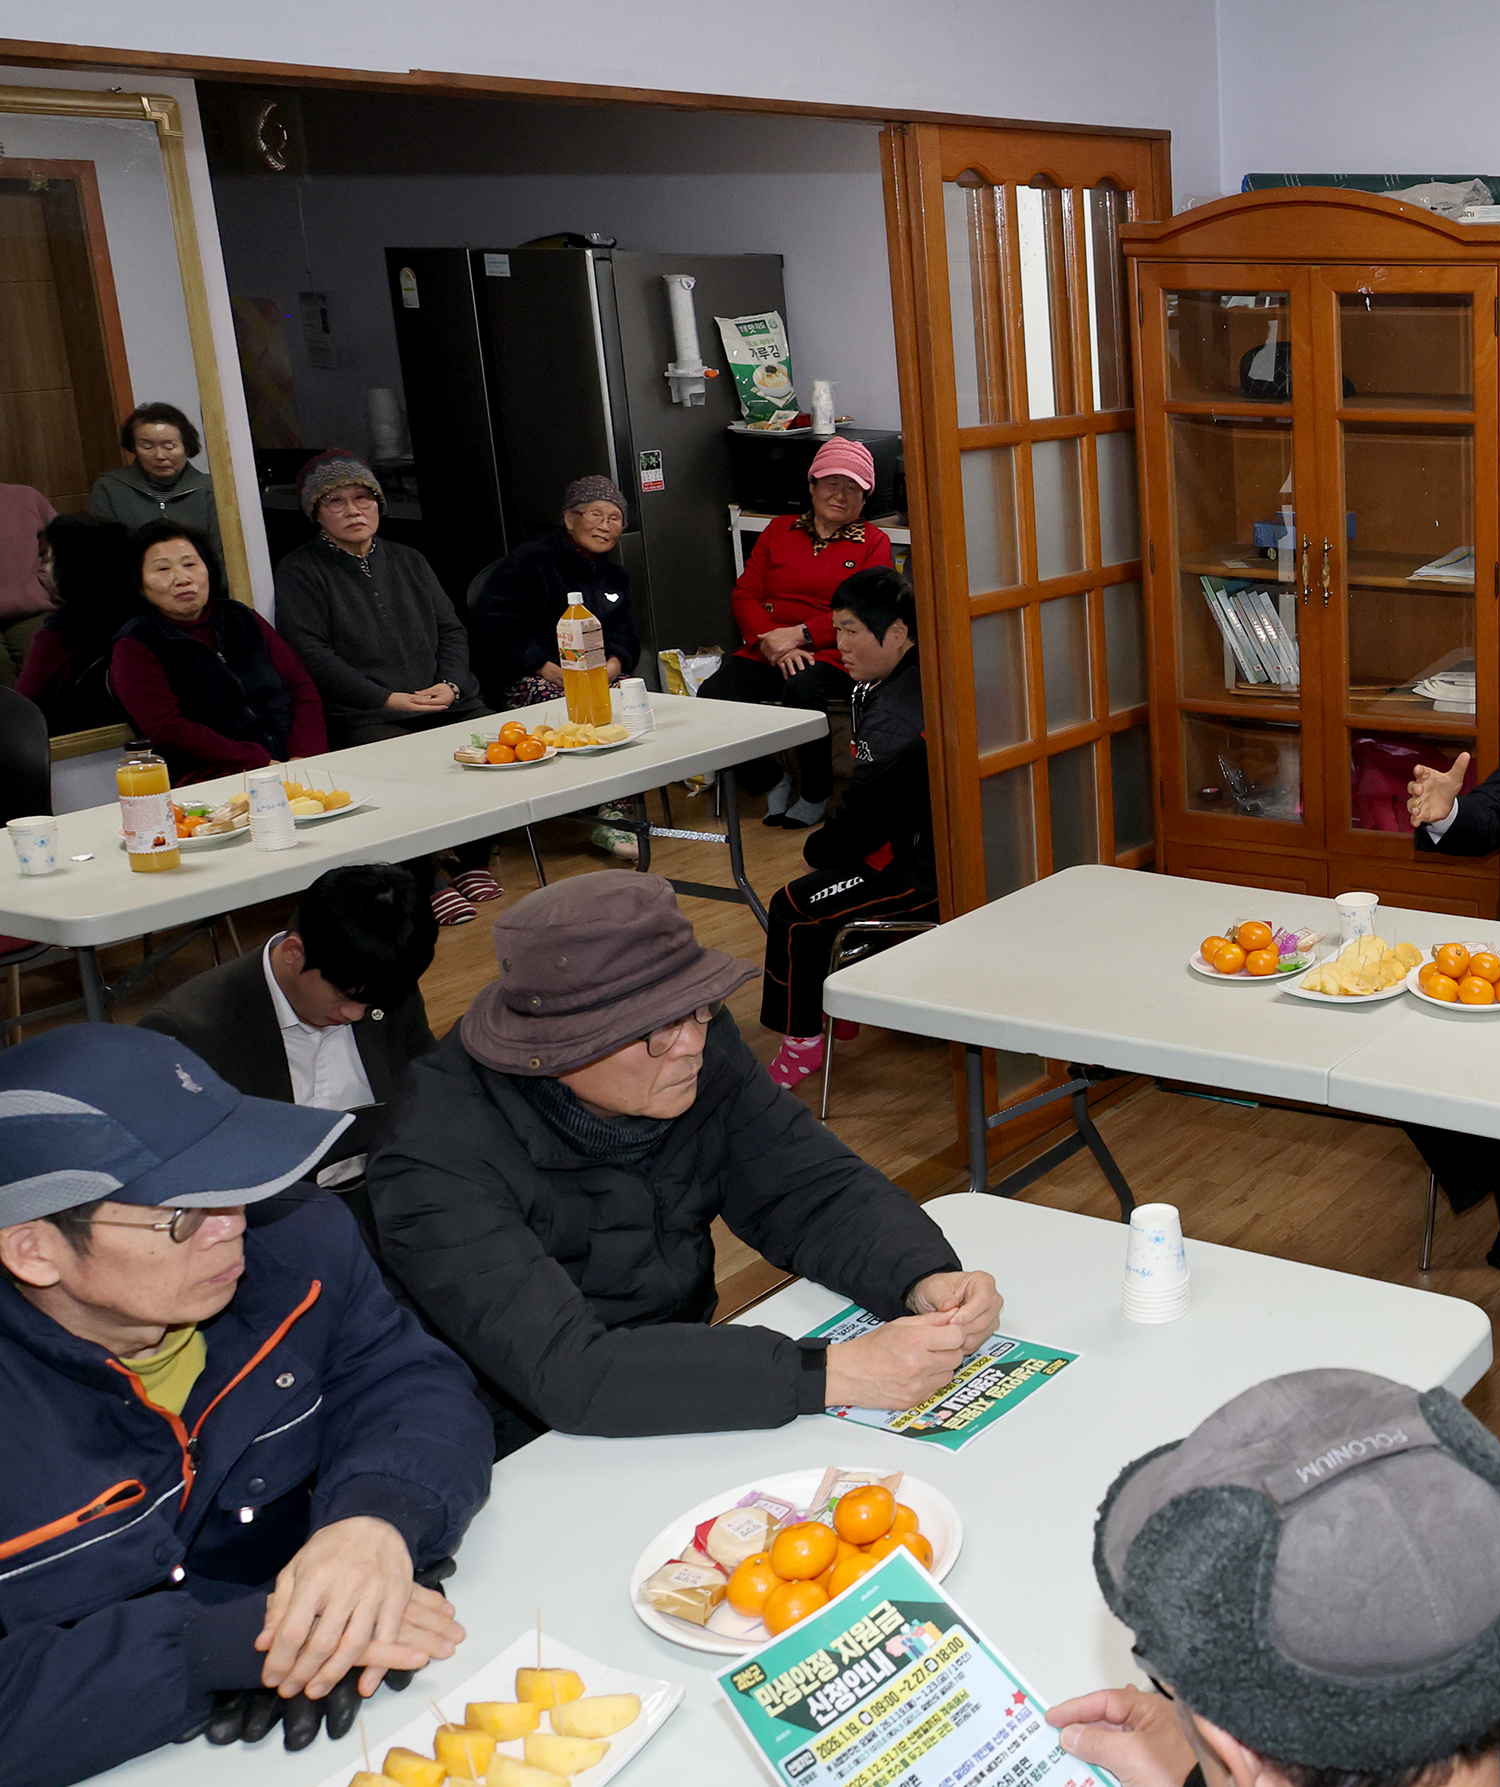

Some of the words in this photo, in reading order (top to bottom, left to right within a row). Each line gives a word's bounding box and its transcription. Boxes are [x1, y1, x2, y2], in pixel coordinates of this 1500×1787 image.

[749, 344, 780, 360] 가루김
[940, 1368, 1006, 1412] 신청안내
[983, 1357, 1049, 1400] 민생안정
[941, 1397, 996, 1431] 지원금
[1295, 1428, 1408, 1484] POLONIUM
[752, 1644, 840, 1720] 민생안정
[828, 1597, 906, 1667] 지원금
[803, 1645, 897, 1728] 신청안내
[815, 1718, 862, 1759] 2026.1.19.
[869, 1690, 900, 1718] 09:00
[935, 1635, 964, 1664] 18:00
[907, 1744, 924, 1761] 두고
[921, 1732, 939, 1750] 있는
[935, 1720, 953, 1738] 군민
[991, 1726, 1009, 1746] 신청
[1005, 1718, 1017, 1732] 및
[1014, 1705, 1032, 1724] 지급
[1011, 1755, 1032, 1777] 읍면
[1029, 1759, 1050, 1783] 방문
